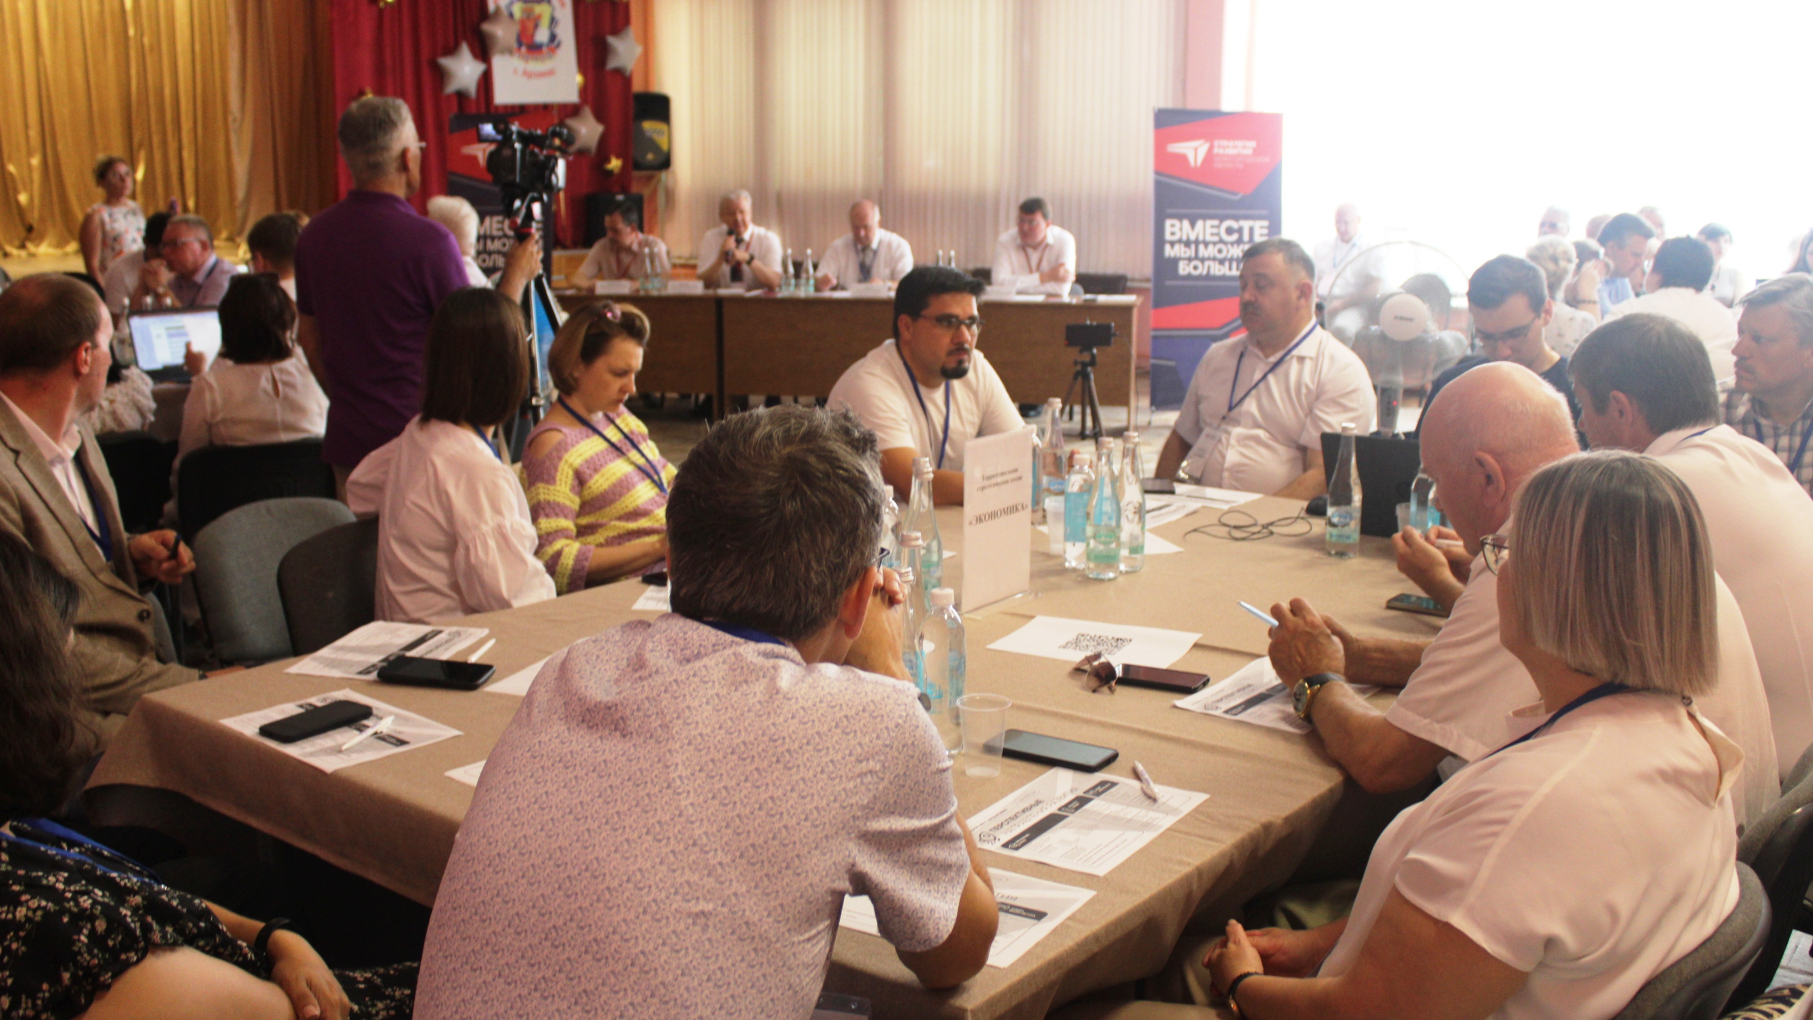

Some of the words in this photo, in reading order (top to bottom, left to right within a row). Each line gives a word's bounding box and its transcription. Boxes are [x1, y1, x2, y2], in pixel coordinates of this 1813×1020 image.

[1164, 218, 1269, 242] ВМЕСТЕ
[1164, 243, 1196, 258] МЫ
[1198, 243, 1252, 259] МОЖ
[1178, 260, 1244, 276] БОЛЬШ
[968, 502, 1029, 527] «ЭКОНОМИКА»
